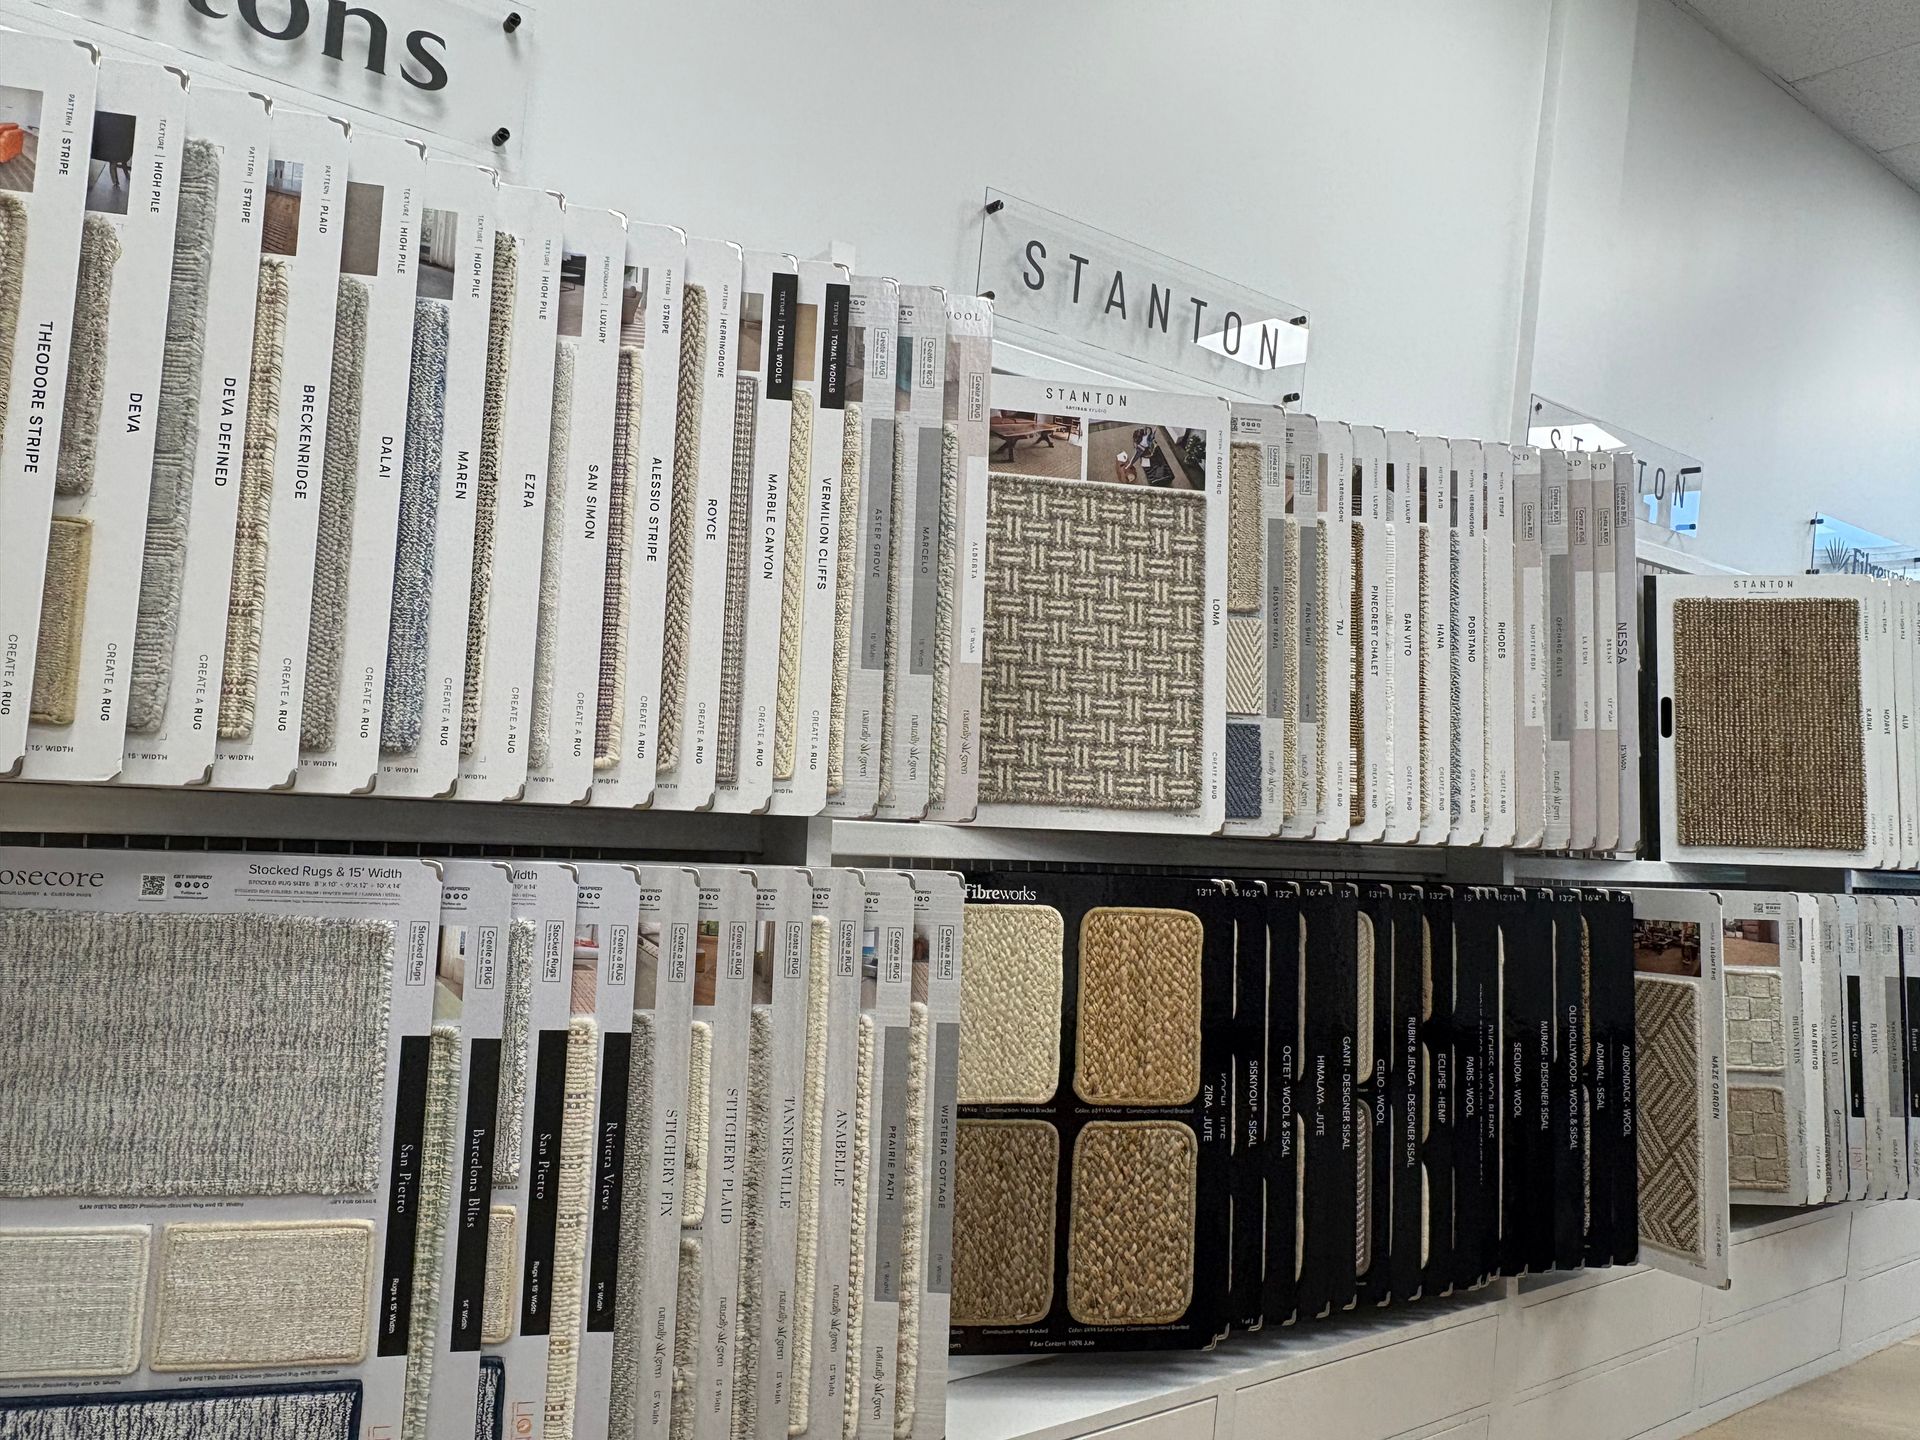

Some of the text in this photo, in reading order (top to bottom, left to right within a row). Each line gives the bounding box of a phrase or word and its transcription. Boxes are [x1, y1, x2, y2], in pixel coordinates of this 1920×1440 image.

[188, 0, 449, 91] ons
[58, 138, 71, 176] STRIPE
[154, 161, 163, 187] HIGH
[150, 190, 162, 213] PILE
[242, 187, 253, 224] STRIPE
[319, 205, 328, 234] PLAID
[398, 254, 406, 275] PILE
[539, 301, 547, 320] PILE
[662, 304, 670, 334] STRIPE
[1023, 240, 1278, 369] STANTON
[599, 310, 607, 344] LUXURY
[775, 354, 783, 384] WOOLS
[24, 322, 53, 473] THEODORE STRIPE
[127, 393, 142, 433] DEVA
[1046, 387, 1127, 407] STANTON
[215, 378, 236, 486] DEVA DEFINED
[295, 385, 315, 499] BRECKENRIDGE
[379, 436, 393, 478] DALAI
[455, 451, 469, 499] MAREN
[1550, 428, 1685, 508] STTON
[523, 474, 536, 508] EZRA
[584, 465, 598, 539] SAN SIMON
[647, 457, 662, 562] ALESSIO STRIPE
[706, 499, 718, 540] ROYCE
[764, 474, 778, 579] MARBLE CANYON
[817, 478, 832, 590] VERMILION CLIFFS
[873, 546, 881, 578] GROVE
[1734, 580, 1794, 589] STANTON
[1212, 598, 1220, 626] LOMA
[6, 634, 18, 677] CREATE
[1618, 622, 1627, 664] NESSA
[104, 643, 117, 684] CREATE
[197, 654, 208, 694] CREATE
[281, 658, 291, 697] CREATE
[0, 691, 12, 715] RUG
[100, 698, 111, 722] RUG
[193, 707, 203, 731] RUG
[278, 709, 287, 732] RUG
[249, 864, 402, 879] Stocked Rugs & 15' Width
[964, 884, 1036, 901] Fibreworks
[414, 925, 427, 981] Stocked Rugs
[485, 930, 495, 959] Create
[549, 924, 561, 979] Stocked Rugs
[617, 929, 625, 955] Create
[483, 967, 492, 985] RUG
[615, 964, 623, 982] RUG
[1408, 1017, 1416, 1045] RUBIK
[1283, 1046, 1291, 1079] OCTET
[1408, 1055, 1416, 1086] JENGA
[1569, 1027, 1577, 1082] HOLLYWOOD
[1282, 1087, 1291, 1118] WOOL
[1316, 1056, 1325, 1136] HIMALAYA JUTE
[1342, 1074, 1350, 1121] DESIGNER
[1376, 1059, 1385, 1126] CELIO WOOL
[1438, 1054, 1446, 1123] ECLIPSE HEMP
[1466, 1056, 1474, 1118] PARIS WOOL
[1569, 1089, 1577, 1115] WOOL
[1622, 1044, 1631, 1137] ADIRONDACK WOOL
[1712, 1083, 1720, 1120] GARDEN
[1203, 1085, 1213, 1141] ZIRA JUTE
[1407, 1094, 1415, 1140] DESIGNER
[780, 1096, 795, 1210] TANNERSVILLE
[834, 1109, 847, 1187] ANABELLE
[1249, 1120, 1257, 1147] SISAL
[1282, 1130, 1290, 1157] SISAL
[1342, 1122, 1350, 1149] SISAL
[537, 1133, 551, 1200] San Pietro
[602, 1122, 618, 1211] Riviera Views
[720, 1088, 738, 1225] STITCHERY PLAID
[883, 1125, 896, 1201] PRAIRIE PATH
[938, 1104, 949, 1209] WISTERIA COTTAGE
[1407, 1143, 1415, 1168] SISAL
[397, 1144, 413, 1213] San Pietro
[467, 1129, 485, 1229] Barcelona Bliss
[660, 1193, 673, 1217] FIX
